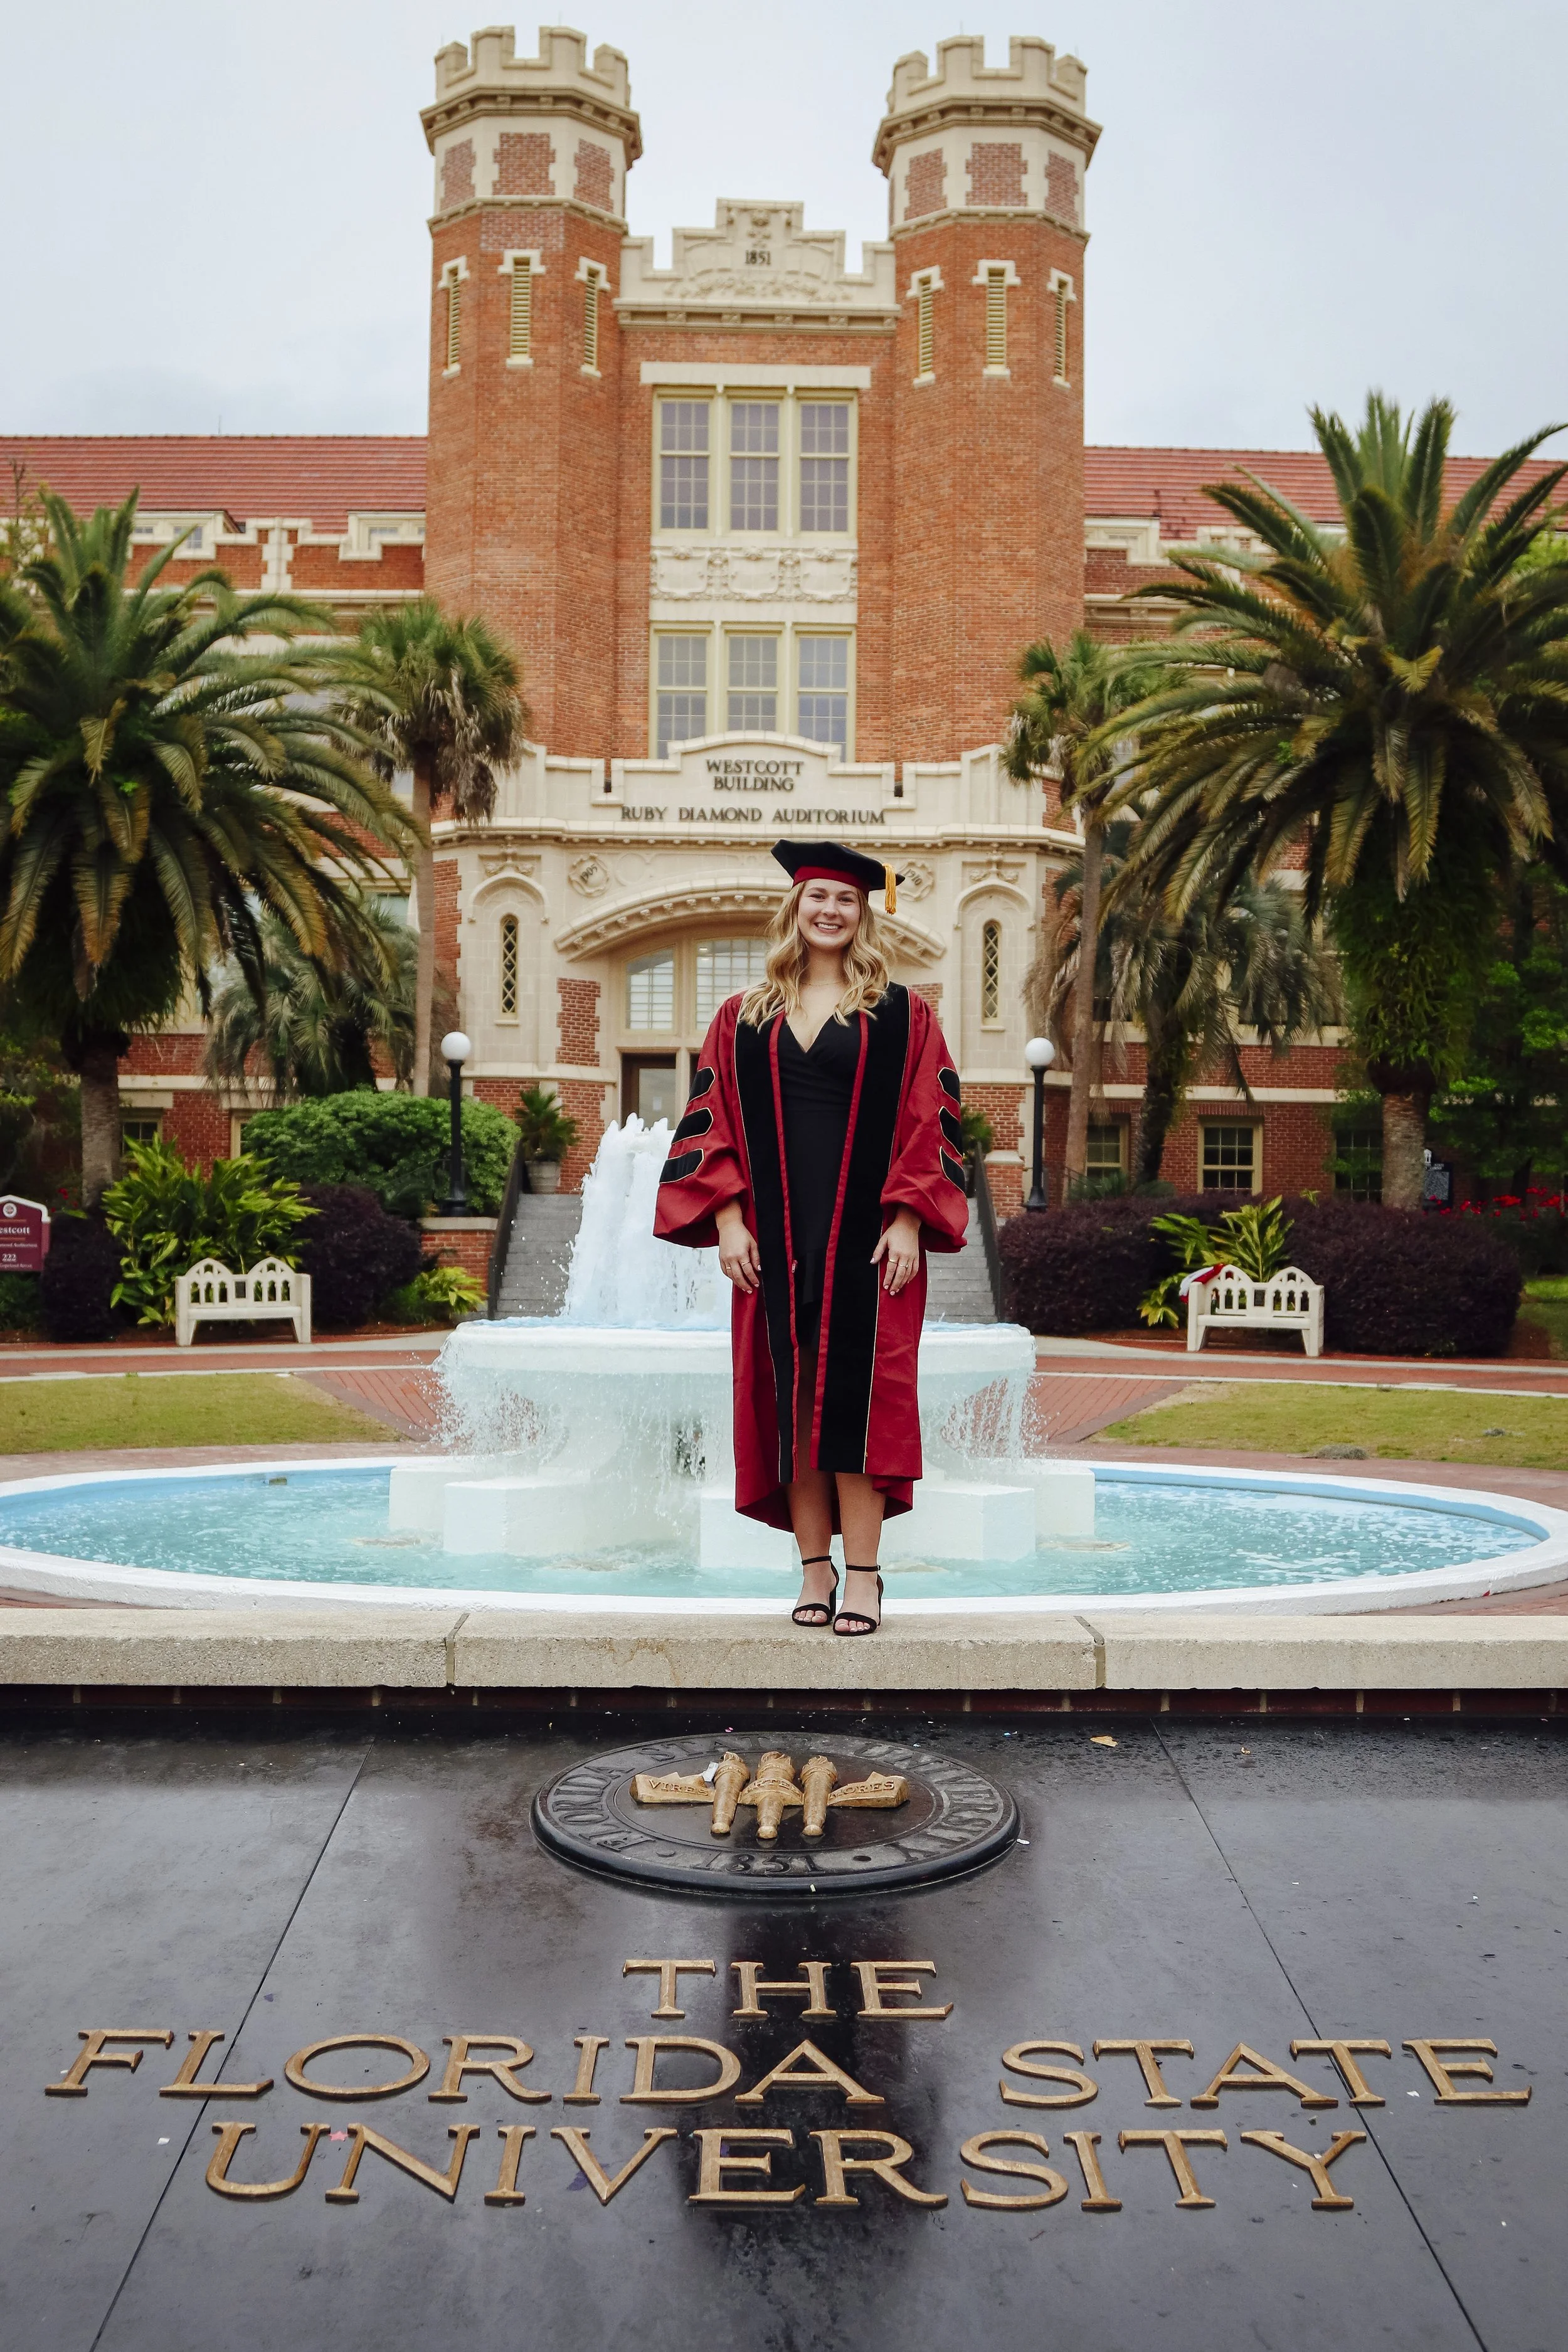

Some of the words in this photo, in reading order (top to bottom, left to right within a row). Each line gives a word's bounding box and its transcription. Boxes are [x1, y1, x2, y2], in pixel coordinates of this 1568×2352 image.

[744, 250, 771, 265] 1851
[706, 758, 805, 775] WESTCOTT
[713, 776, 795, 793] BUILDING
[621, 805, 668, 820] RUBY
[679, 807, 762, 822] DIAMOND
[771, 808, 886, 825] AUDITORIUM
[580, 863, 598, 884] 1905
[903, 868, 923, 886] 1910
[0, 1226, 30, 1234] estcott
[2, 1253, 16, 1262] 222
[648, 1778, 709, 1796] VIRES
[829, 1779, 895, 1799] MORES
[551, 1765, 656, 1851] FLORIDA
[854, 1743, 999, 1862] UNIVERSITY
[691, 1851, 825, 1877] 1851
[623, 1959, 954, 2020] THE
[45, 2028, 885, 2107] FLORIDA
[999, 2038, 1532, 2109] STATE
[204, 2121, 1367, 2212] UNIVERSITY
